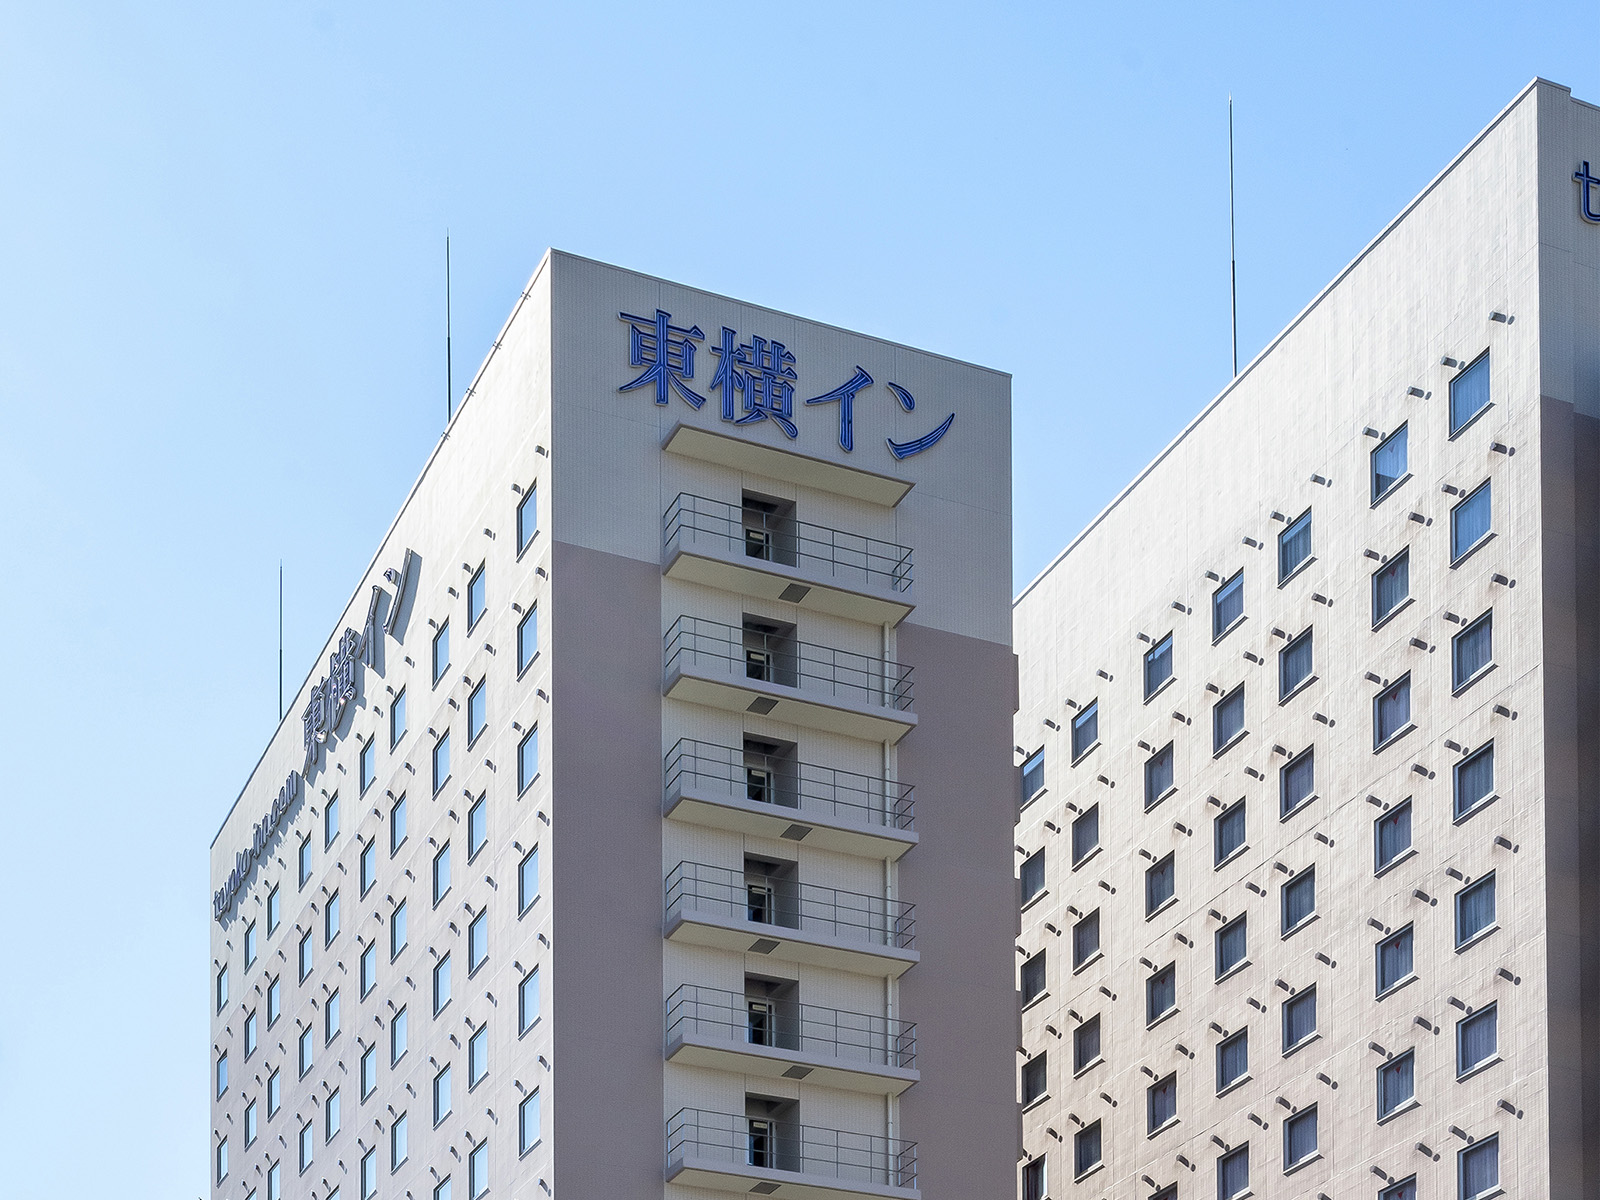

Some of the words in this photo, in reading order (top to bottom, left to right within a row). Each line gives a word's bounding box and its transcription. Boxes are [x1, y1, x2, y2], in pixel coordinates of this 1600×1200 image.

[1574, 160, 1600, 222] t
[618, 308, 956, 461] 東横イン
